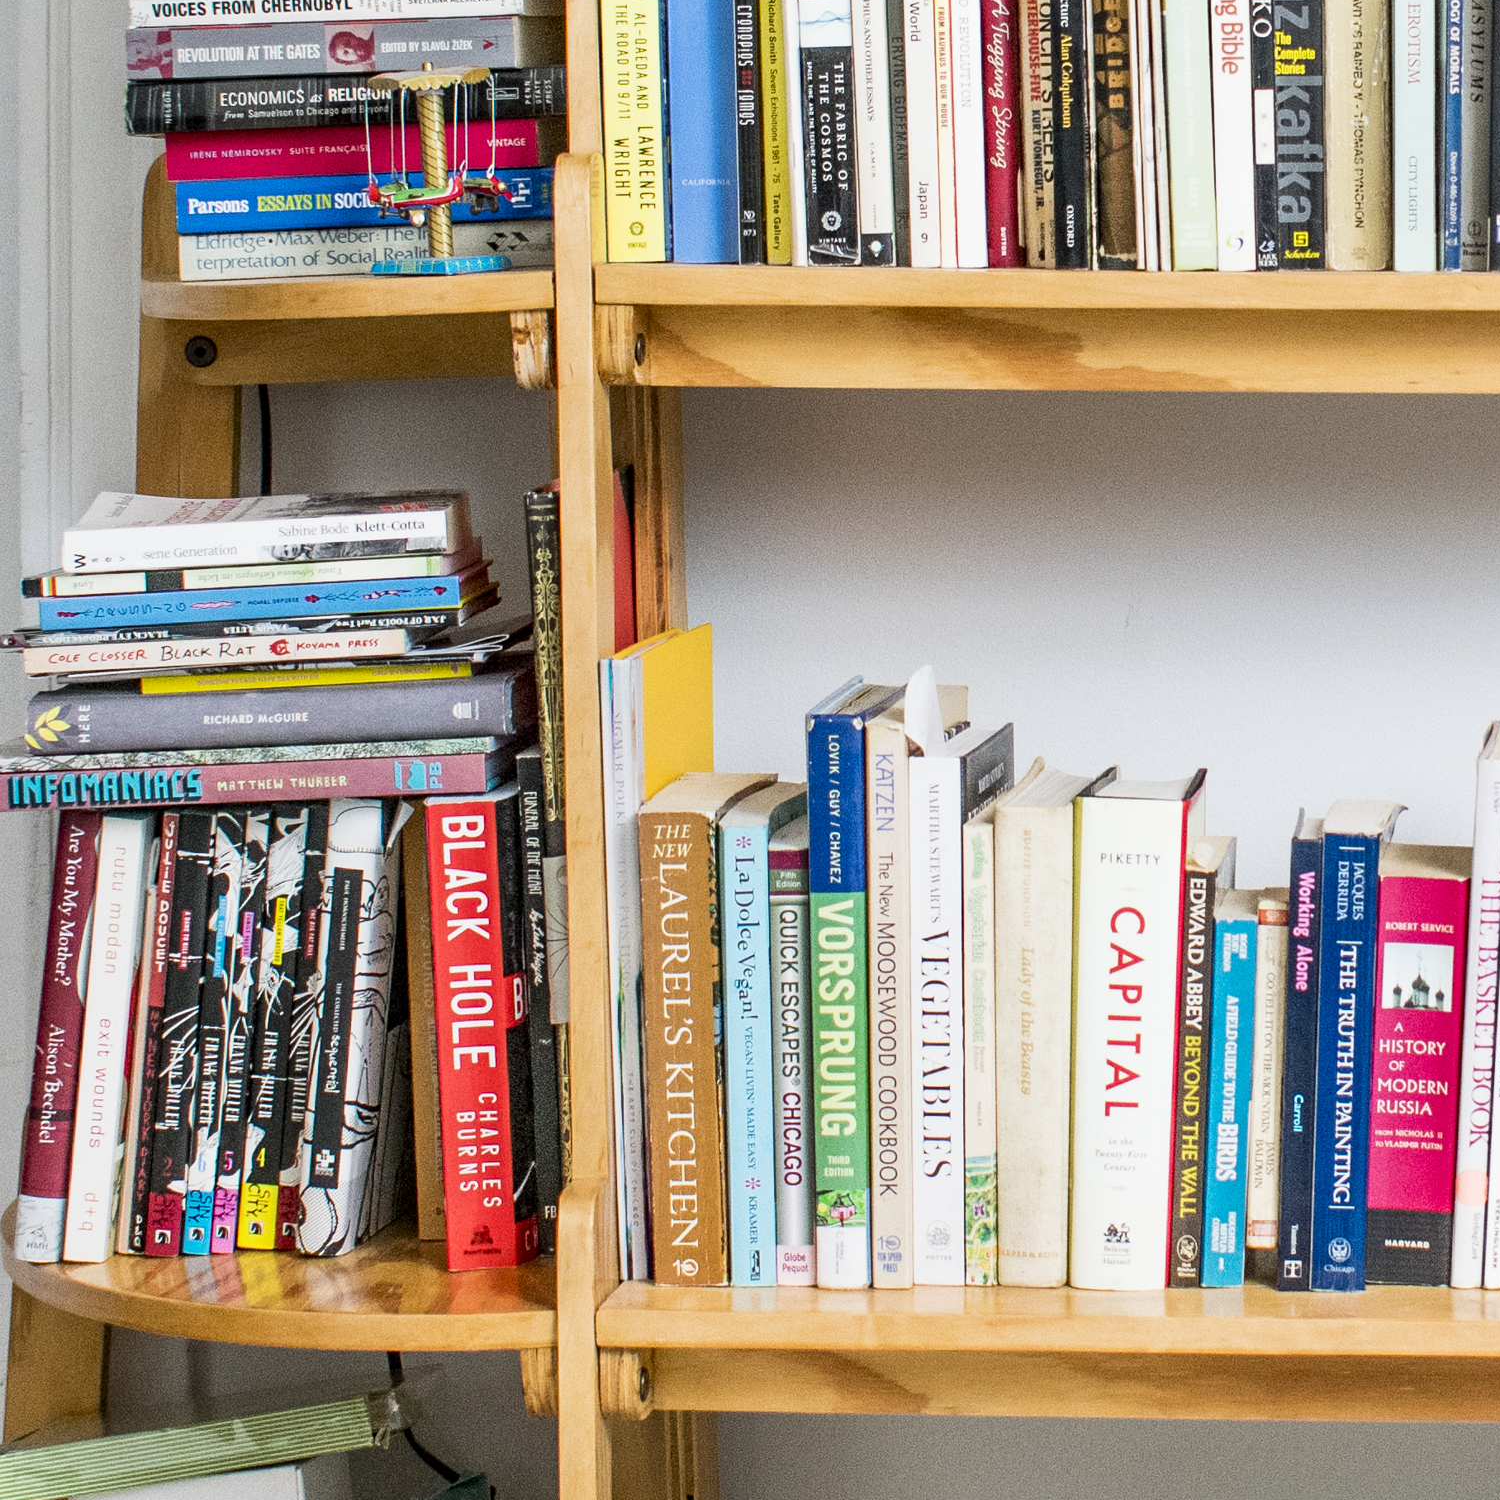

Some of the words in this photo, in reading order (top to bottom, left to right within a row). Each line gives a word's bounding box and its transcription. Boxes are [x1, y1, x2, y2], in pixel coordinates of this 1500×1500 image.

[152, 2, 207, 18] VOICES
[213, 0, 255, 15] FROM
[1221, 21, 1244, 75] Bible
[79, 704, 90, 743] HERE
[203, 712, 254, 724] RICHARD
[258, 711, 309, 722] McGUIRE
[9, 769, 202, 807] INFOMANIACS
[217, 778, 284, 791] MATTHEW
[290, 775, 347, 788] THURBER
[654, 825, 691, 839] THE
[653, 843, 692, 859] NEW
[1100, 853, 1161, 866] PIKETTY
[441, 815, 490, 941] BLACK
[1385, 923, 1418, 932] ROBERT
[1421, 924, 1454, 932] SERVICE
[660, 864, 692, 1046] LAUREL'S
[449, 964, 498, 1071] HOLE
[817, 900, 856, 1135] VORSPRUNG
[1105, 906, 1145, 1118] CAPITAL
[1394, 1022, 1404, 1032] A
[922, 930, 954, 1178] VEGETABLES
[1379, 1040, 1445, 1055] HISTORY
[1390, 1060, 1405, 1071] OF
[1377, 1079, 1448, 1093] MODERN
[1377, 1101, 1432, 1115] RUSSIA
[456, 1111, 479, 1194] BURNS
[479, 1094, 501, 1208] CHARLES
[666, 1060, 699, 1248] KITCHEN
[1385, 1240, 1430, 1248] HARVARD
